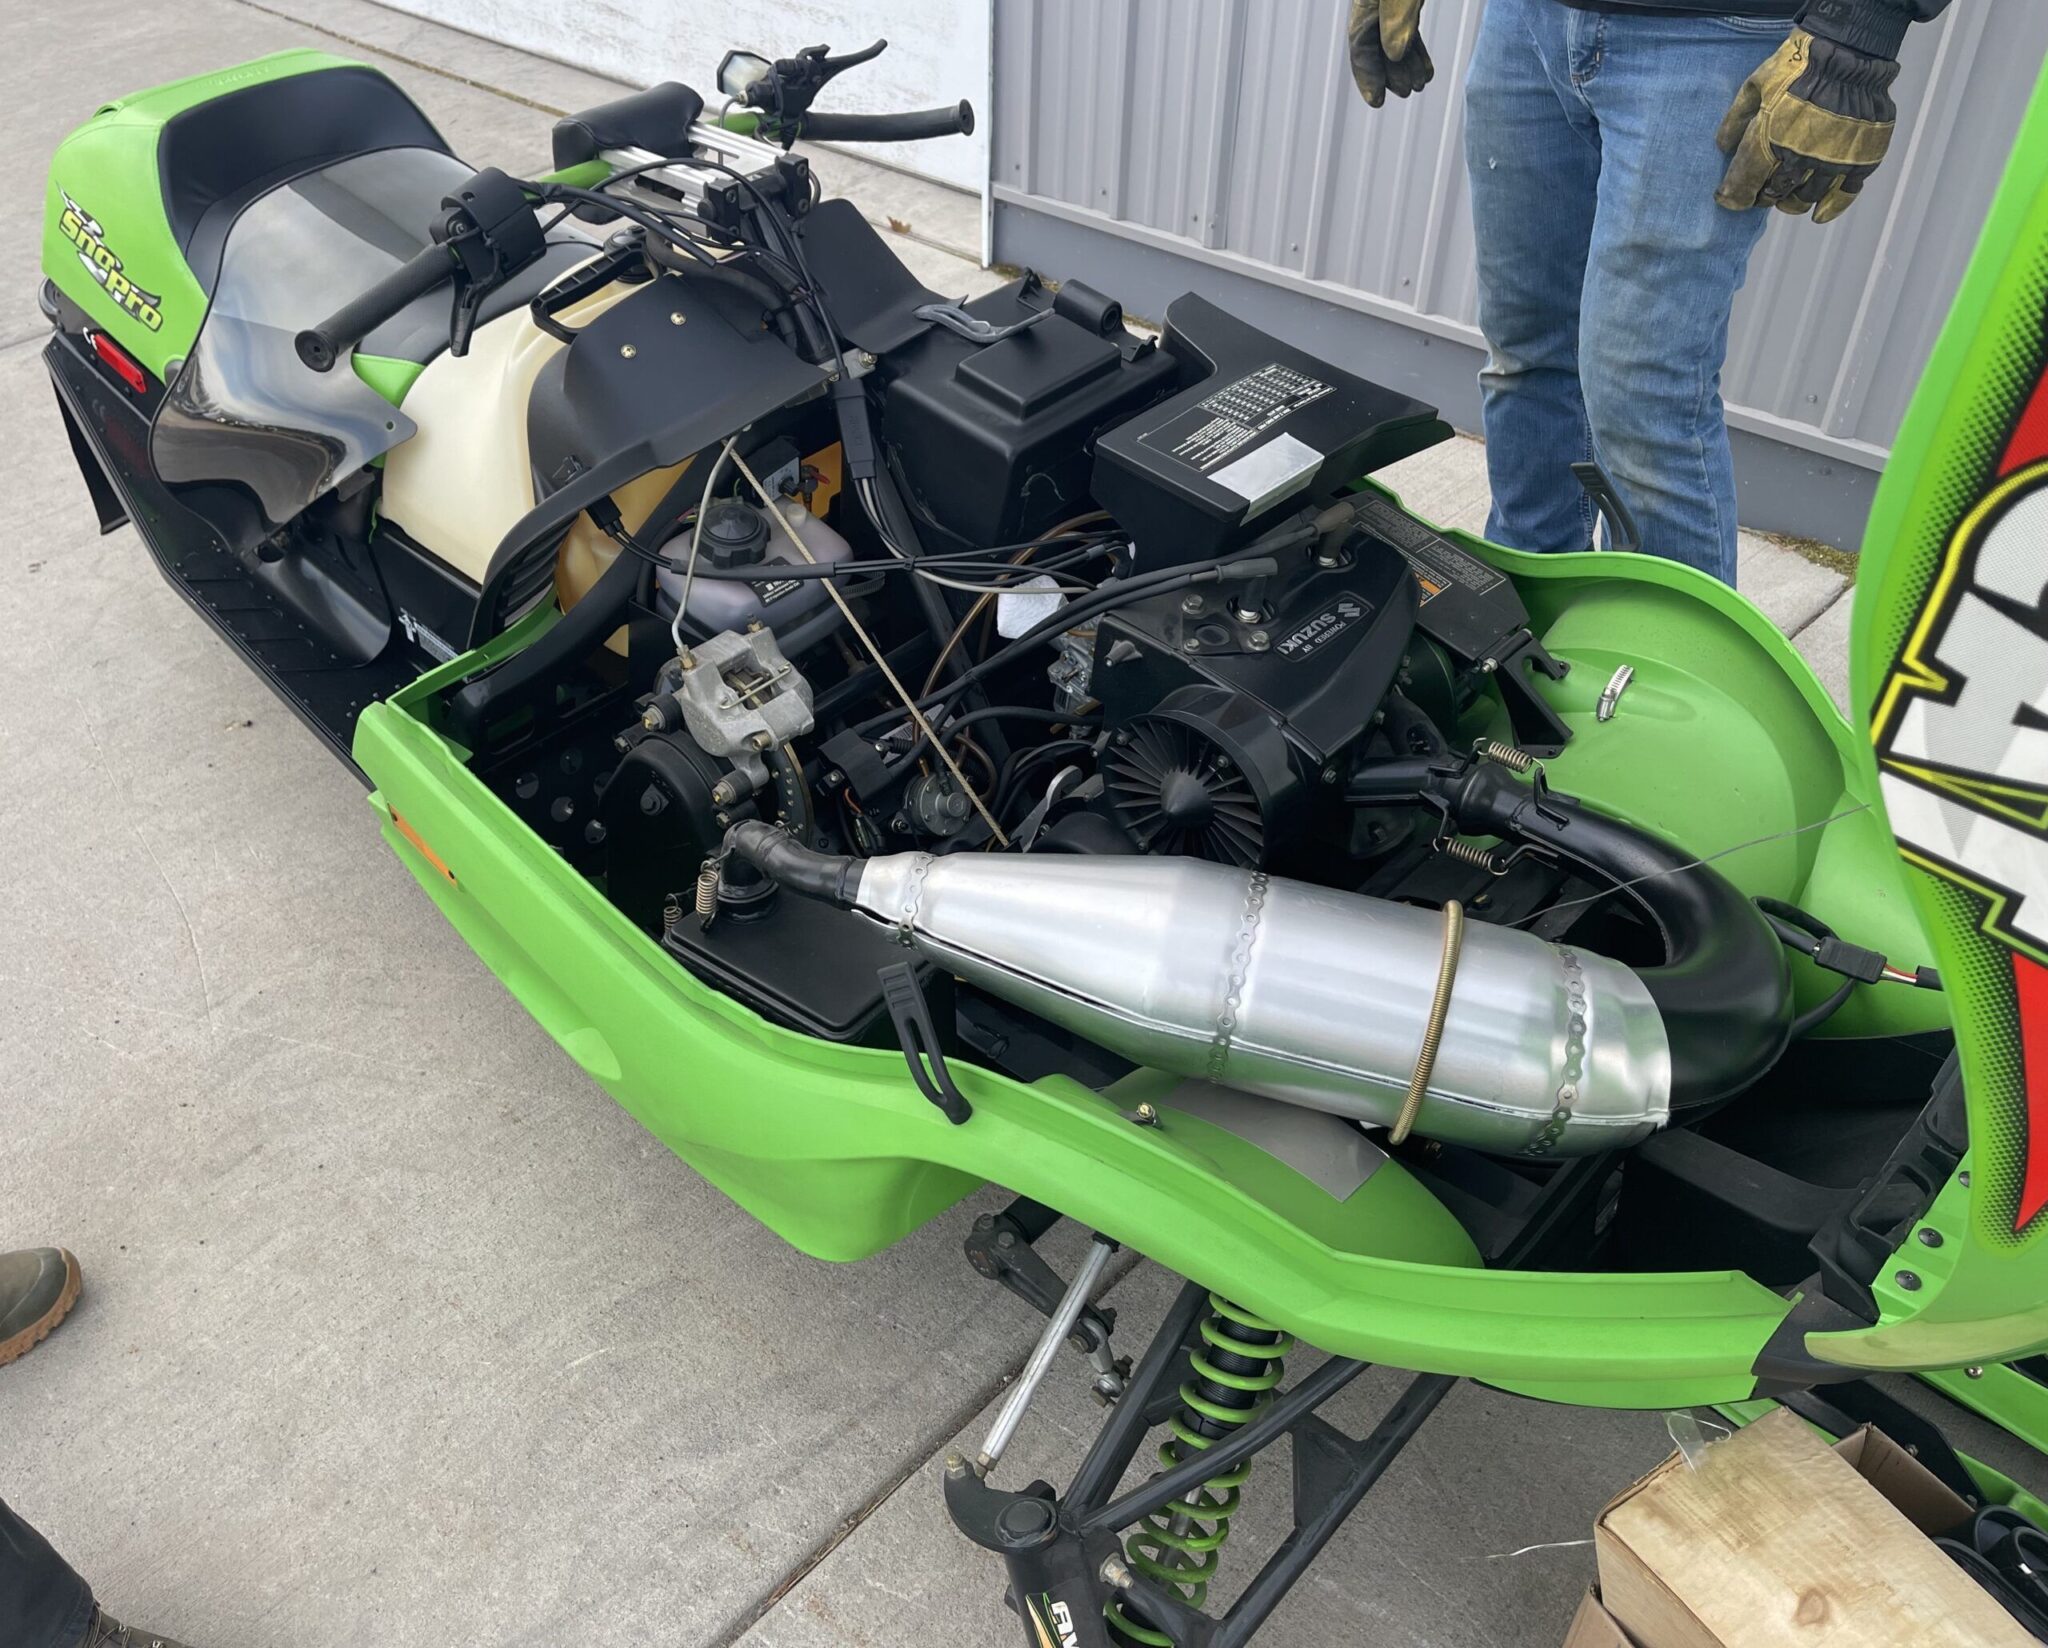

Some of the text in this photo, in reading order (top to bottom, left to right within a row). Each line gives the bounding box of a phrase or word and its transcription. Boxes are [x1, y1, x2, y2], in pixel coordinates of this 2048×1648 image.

[105, 269, 163, 332] Pro
[1276, 612, 1337, 655] SUZUKI
[1315, 620, 1347, 644] POWERED
